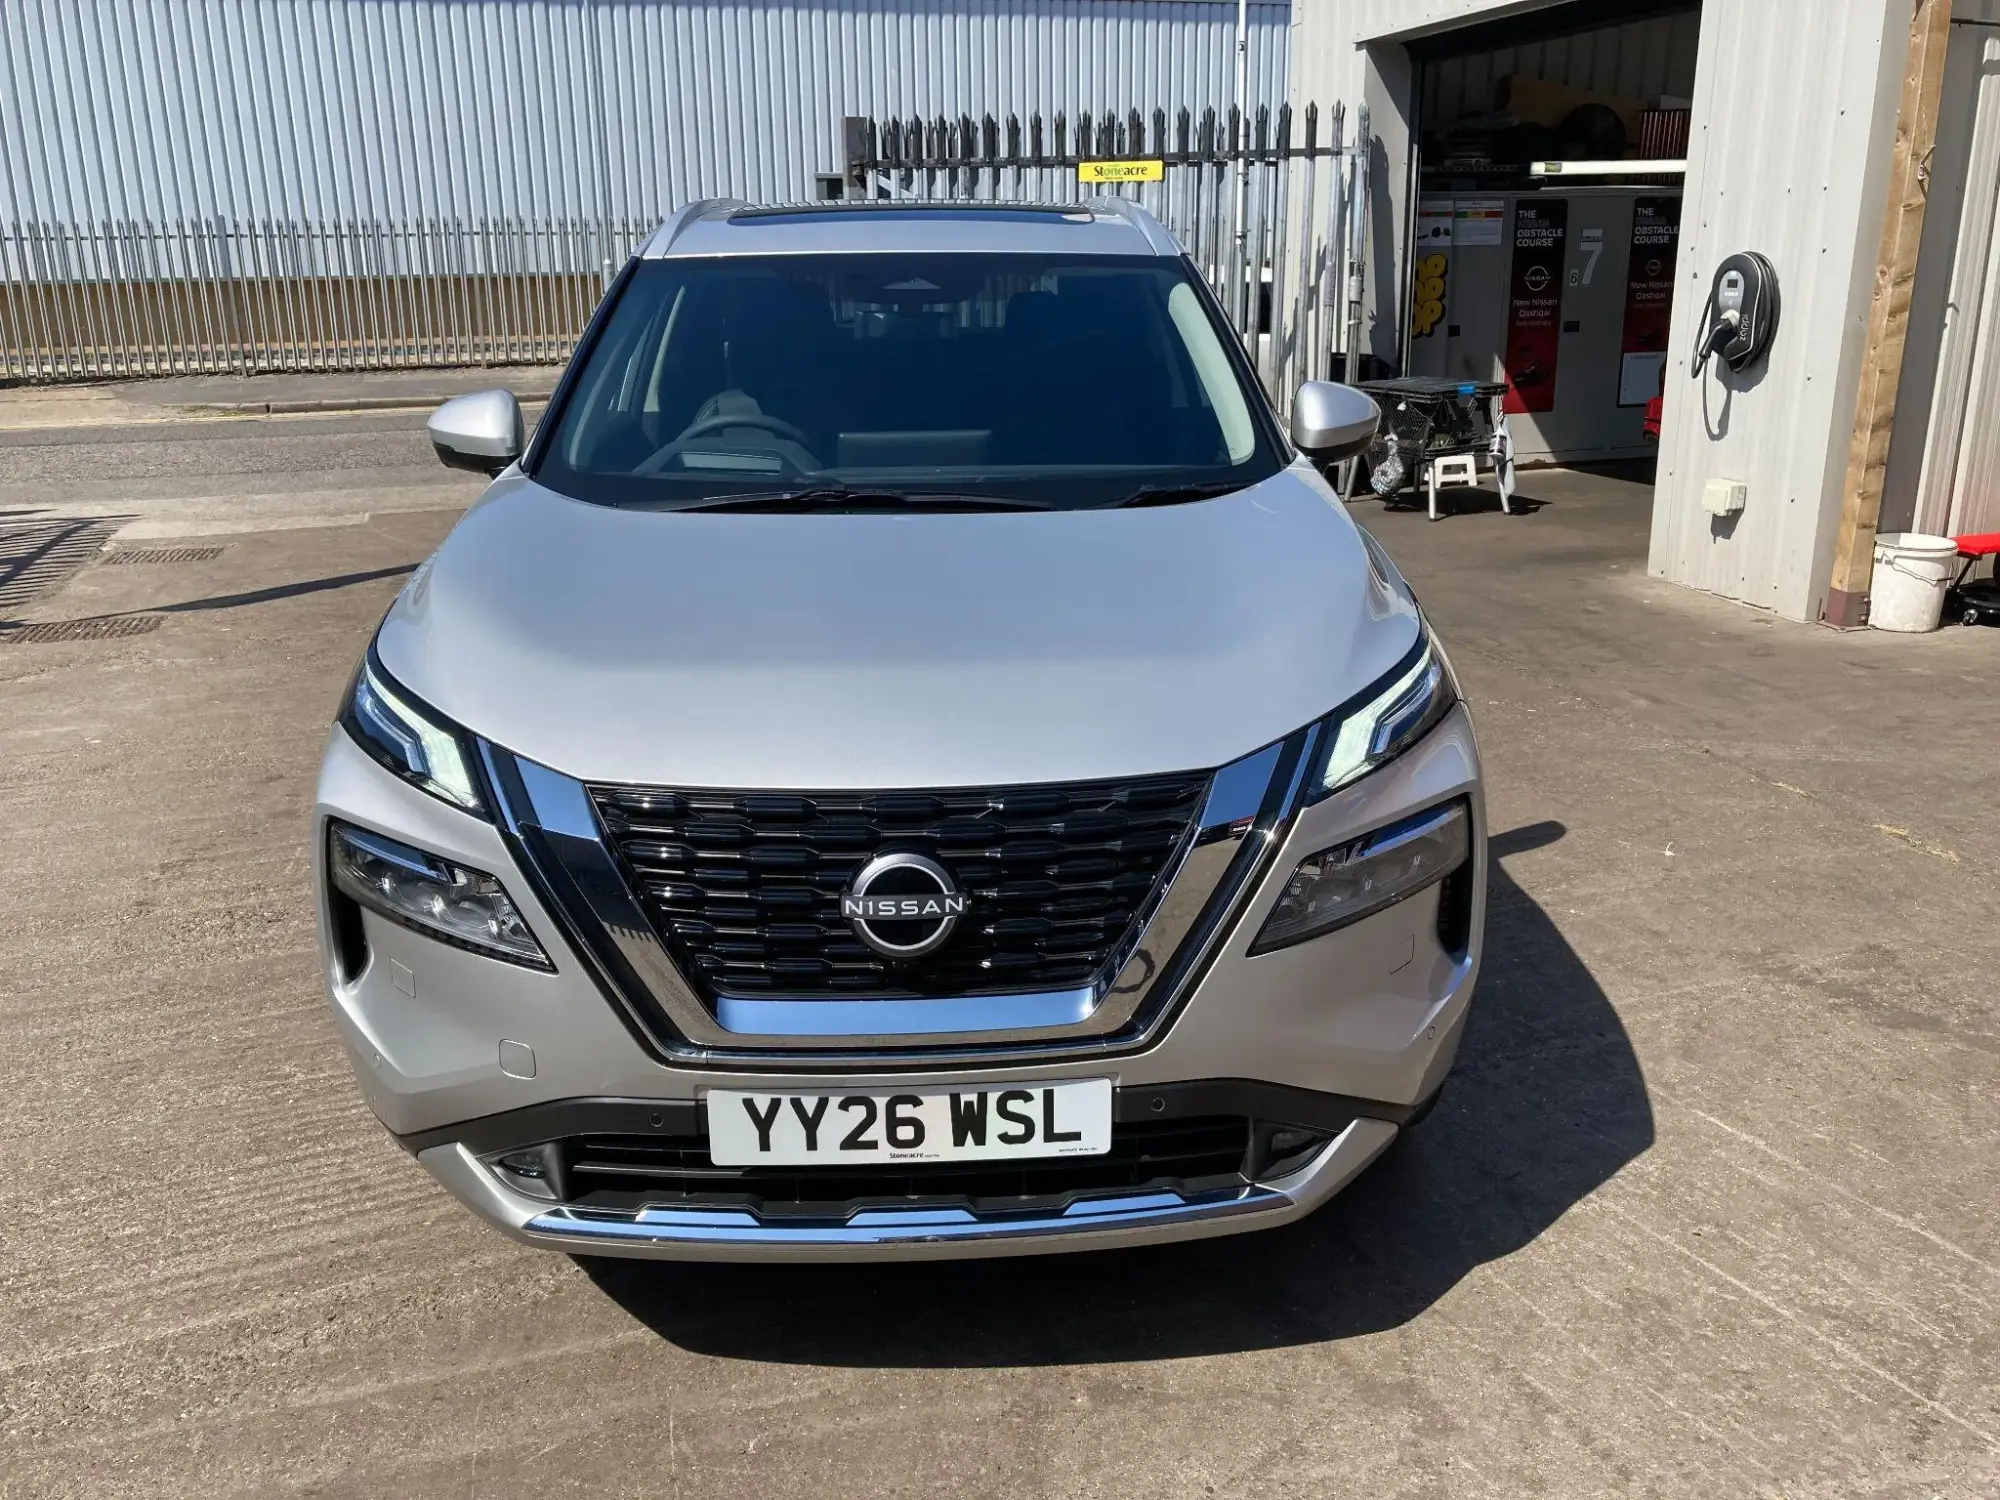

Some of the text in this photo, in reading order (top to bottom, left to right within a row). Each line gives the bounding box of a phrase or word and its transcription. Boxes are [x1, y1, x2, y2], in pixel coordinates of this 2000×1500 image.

[1094, 165, 1148, 177] Stoneacre
[1518, 210, 1537, 219] THE
[1636, 207, 1654, 216] THE
[1517, 228, 1563, 238] OBSTACLE
[1635, 225, 1679, 235] OBSTACLE
[1516, 237, 1554, 247] COURSE
[1634, 235, 1670, 244] COURSE
[1570, 271, 1578, 284] 6
[1513, 298, 1558, 307] New Nissan
[1519, 308, 1551, 318] Qashqai
[845, 897, 963, 916] NISSAN
[742, 1089, 1082, 1152] YY26 WSL
